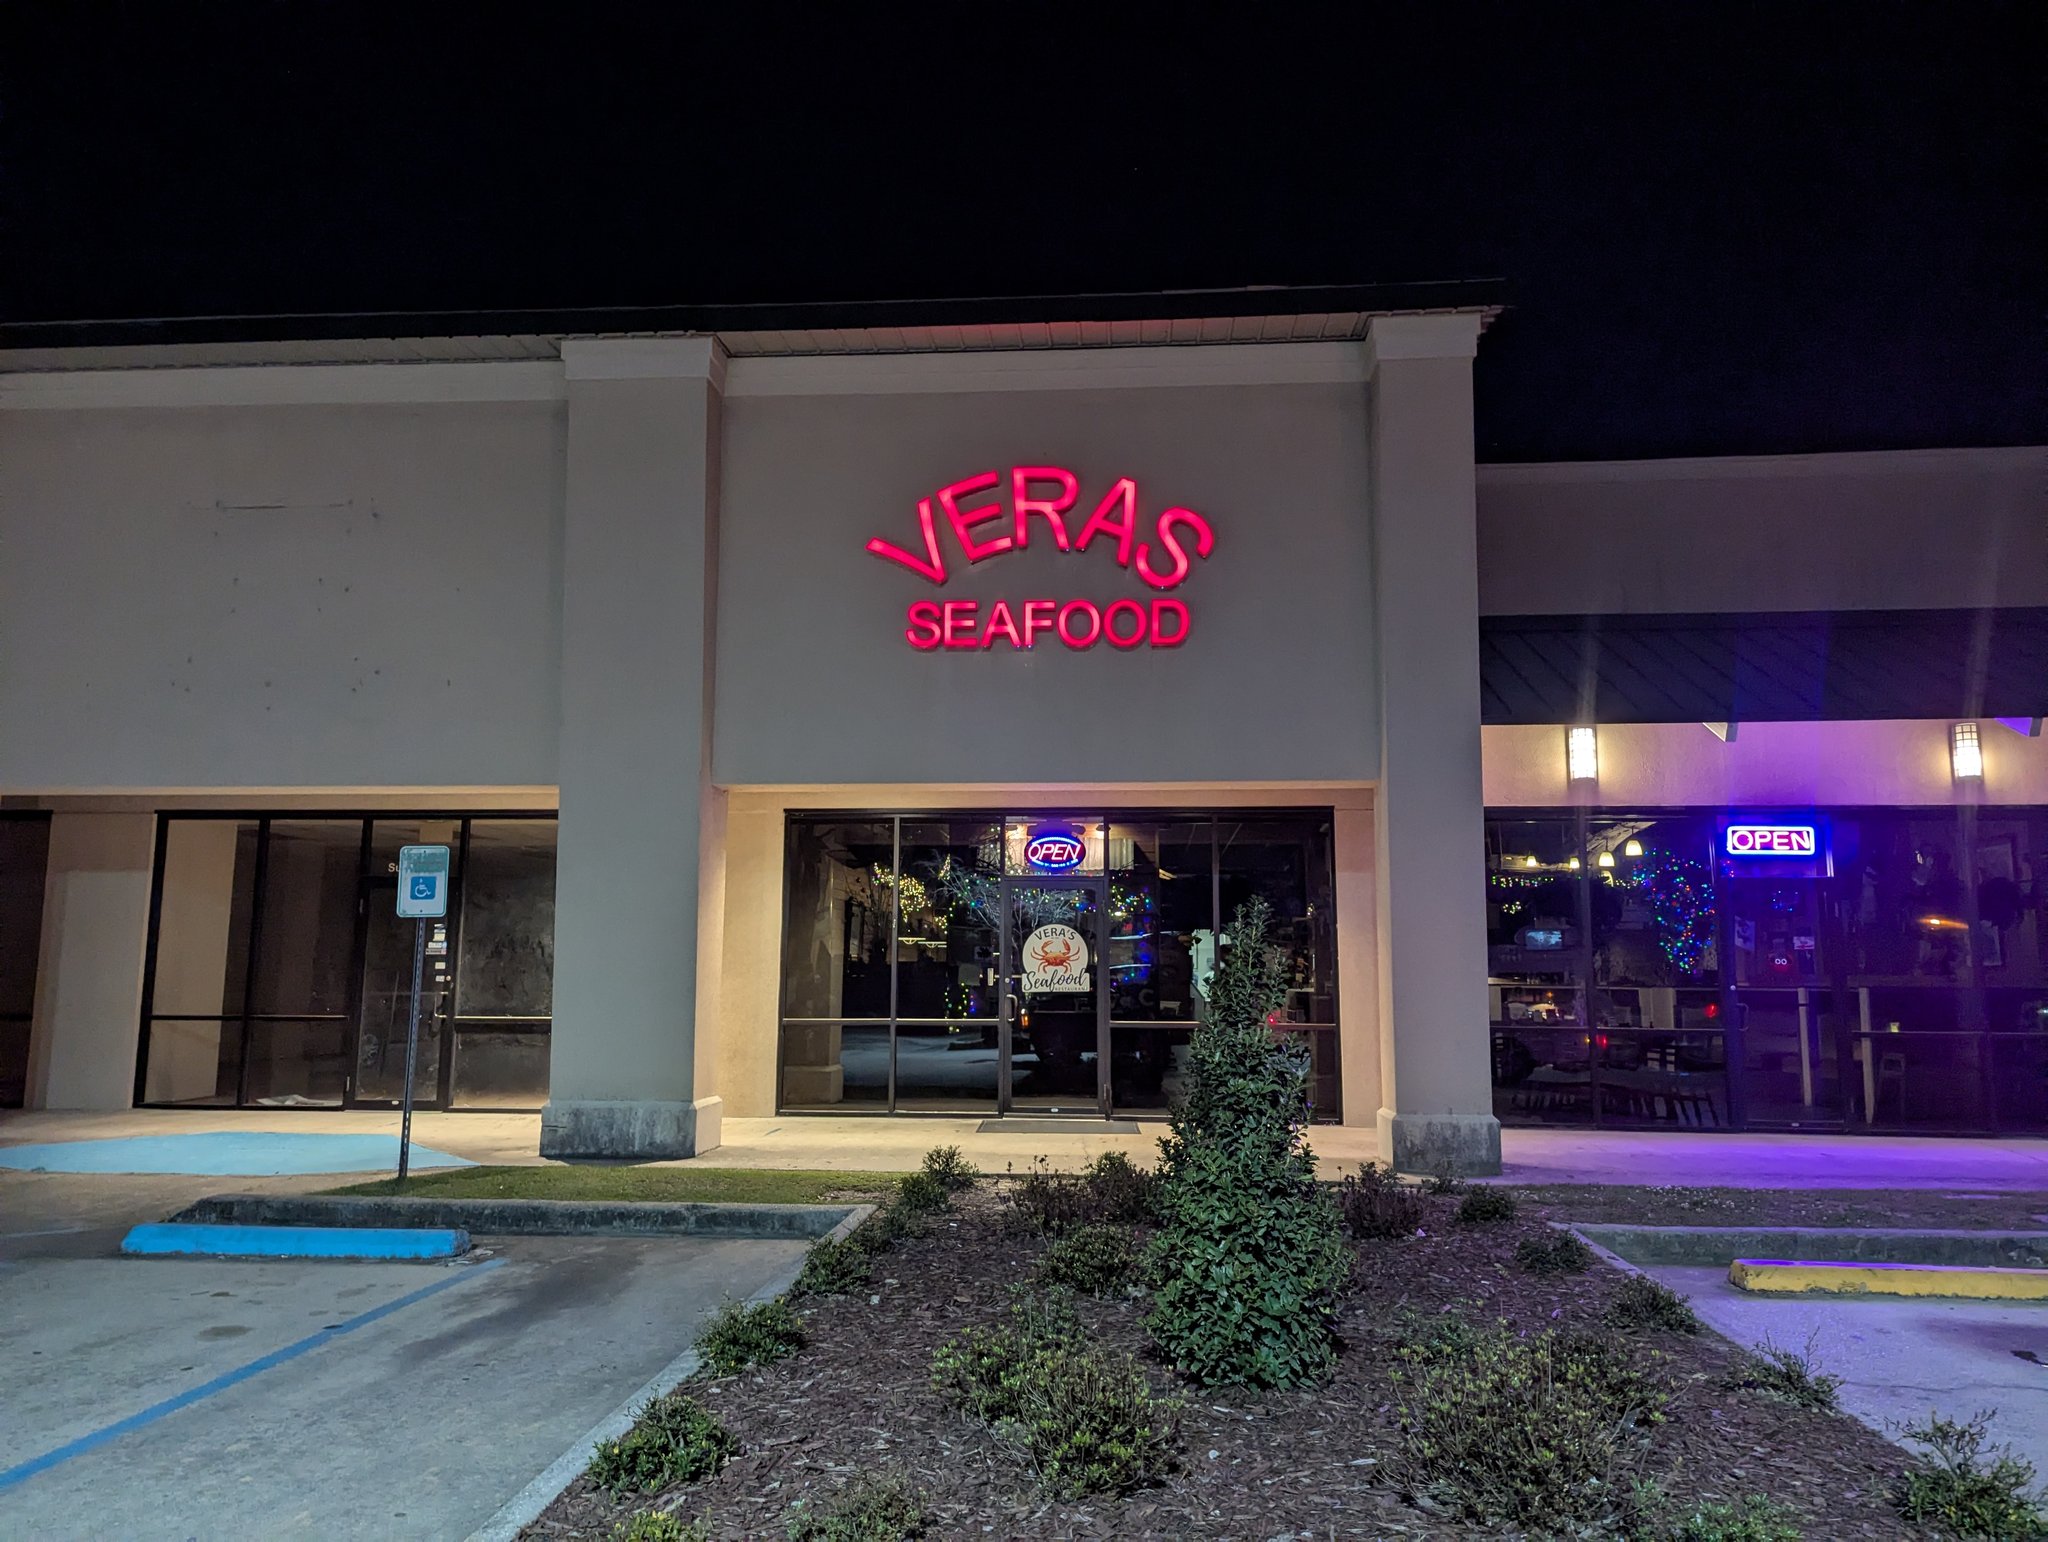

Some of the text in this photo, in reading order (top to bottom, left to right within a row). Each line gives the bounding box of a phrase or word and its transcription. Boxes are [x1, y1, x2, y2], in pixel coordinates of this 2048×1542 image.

[865, 466, 1214, 589] VERAS
[906, 599, 1190, 649] SEAFOOD
[1733, 830, 1810, 850] OPEN
[1028, 843, 1081, 861] OPEN
[1034, 927, 1077, 940] VERA'S
[1023, 967, 1087, 993] Seafood
